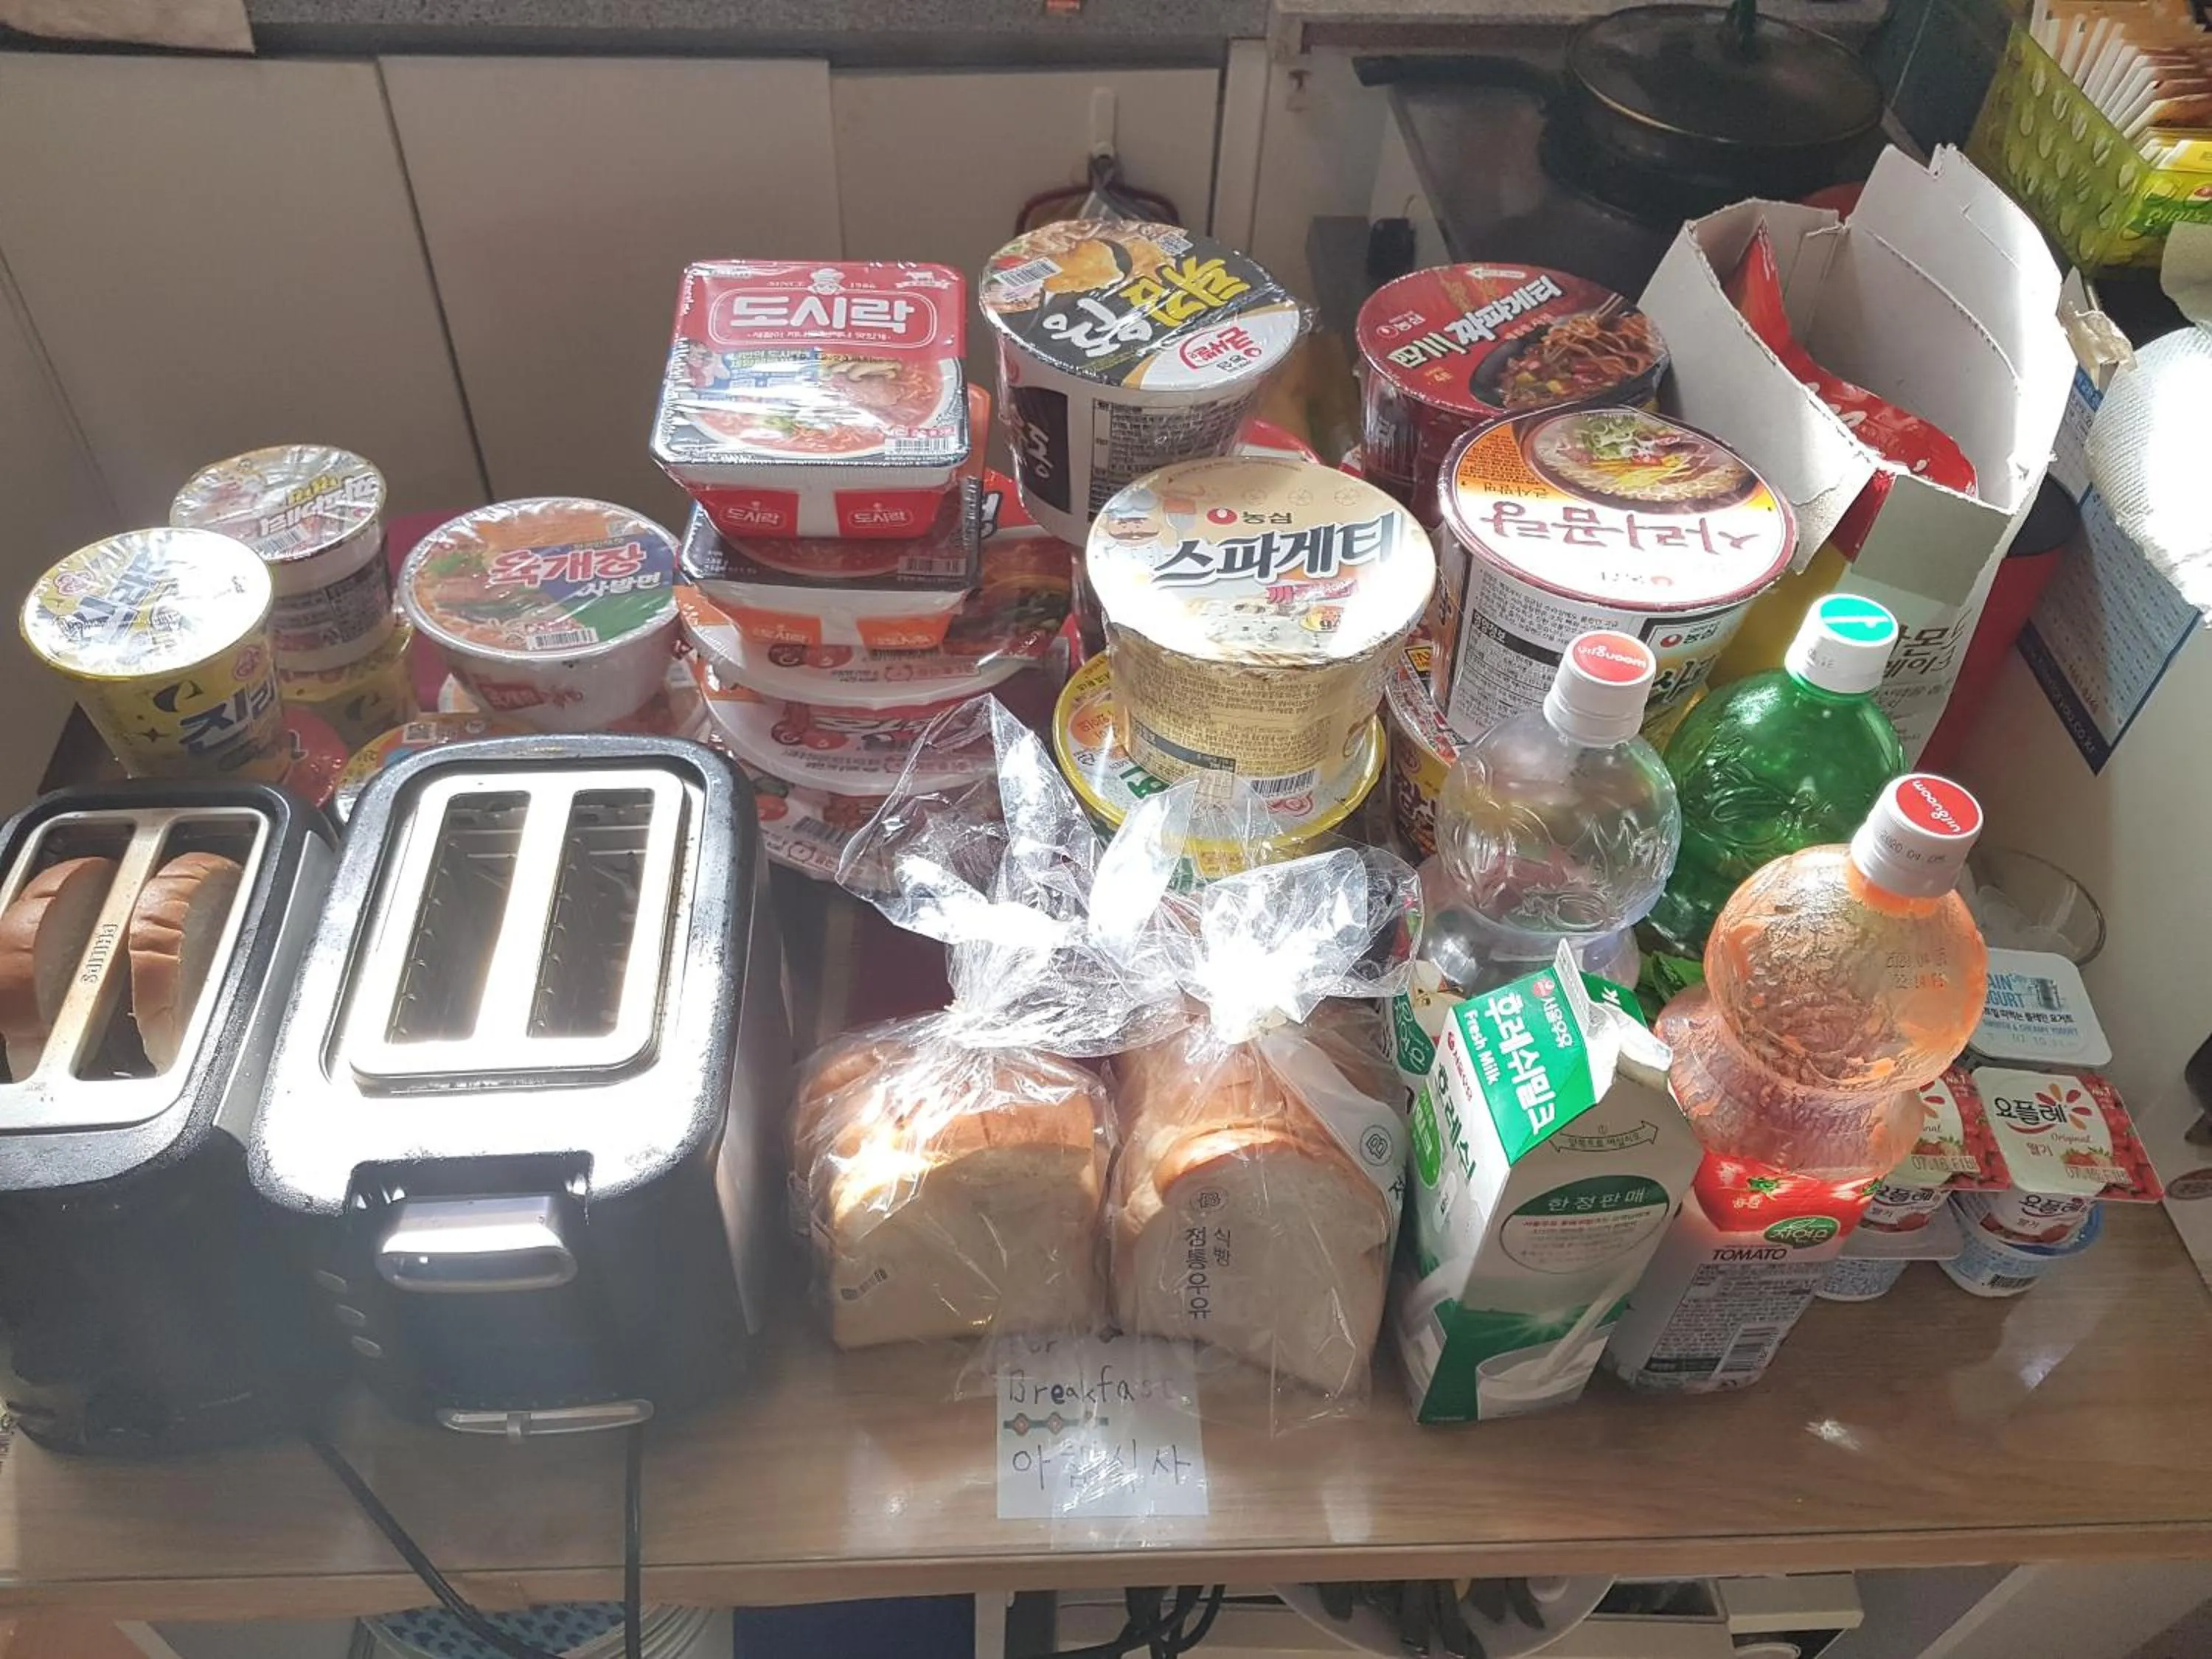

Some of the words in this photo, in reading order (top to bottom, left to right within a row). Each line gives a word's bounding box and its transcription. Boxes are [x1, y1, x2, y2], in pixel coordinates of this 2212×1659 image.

[731, 296, 916, 334] 도시락
[1444, 274, 1562, 345] 짜파게티
[1242, 511, 1293, 525] 농심
[1479, 500, 1761, 555] 사리곰탕
[1152, 509, 1395, 582] 스파게티
[488, 542, 647, 588] 육개장
[576, 572, 661, 597] 사발면
[1576, 644, 1648, 668] woongjin
[1912, 779, 1962, 833] woongjin
[1985, 992, 2027, 1009] GURT
[1986, 973, 2012, 991] AIN
[1541, 997, 1573, 1048] 서울우유
[1464, 1009, 1489, 1051] Fresh
[1478, 1047, 1503, 1086] Milk
[1485, 992, 1557, 1135] 후레쉬밀크
[1994, 1096, 2067, 1126] 요플레
[2027, 1141, 2053, 1158] 딸기
[2051, 1131, 2092, 1144] Original
[1548, 1186, 1646, 1212] 한정판매
[1214, 1226, 1231, 1267] 식빵
[1770, 1227, 1829, 1244] 자연은
[1185, 1225, 1211, 1321] 정통우유
[1711, 1248, 1788, 1262] TOMATO
[1009, 1364, 1176, 1405] Breakfast
